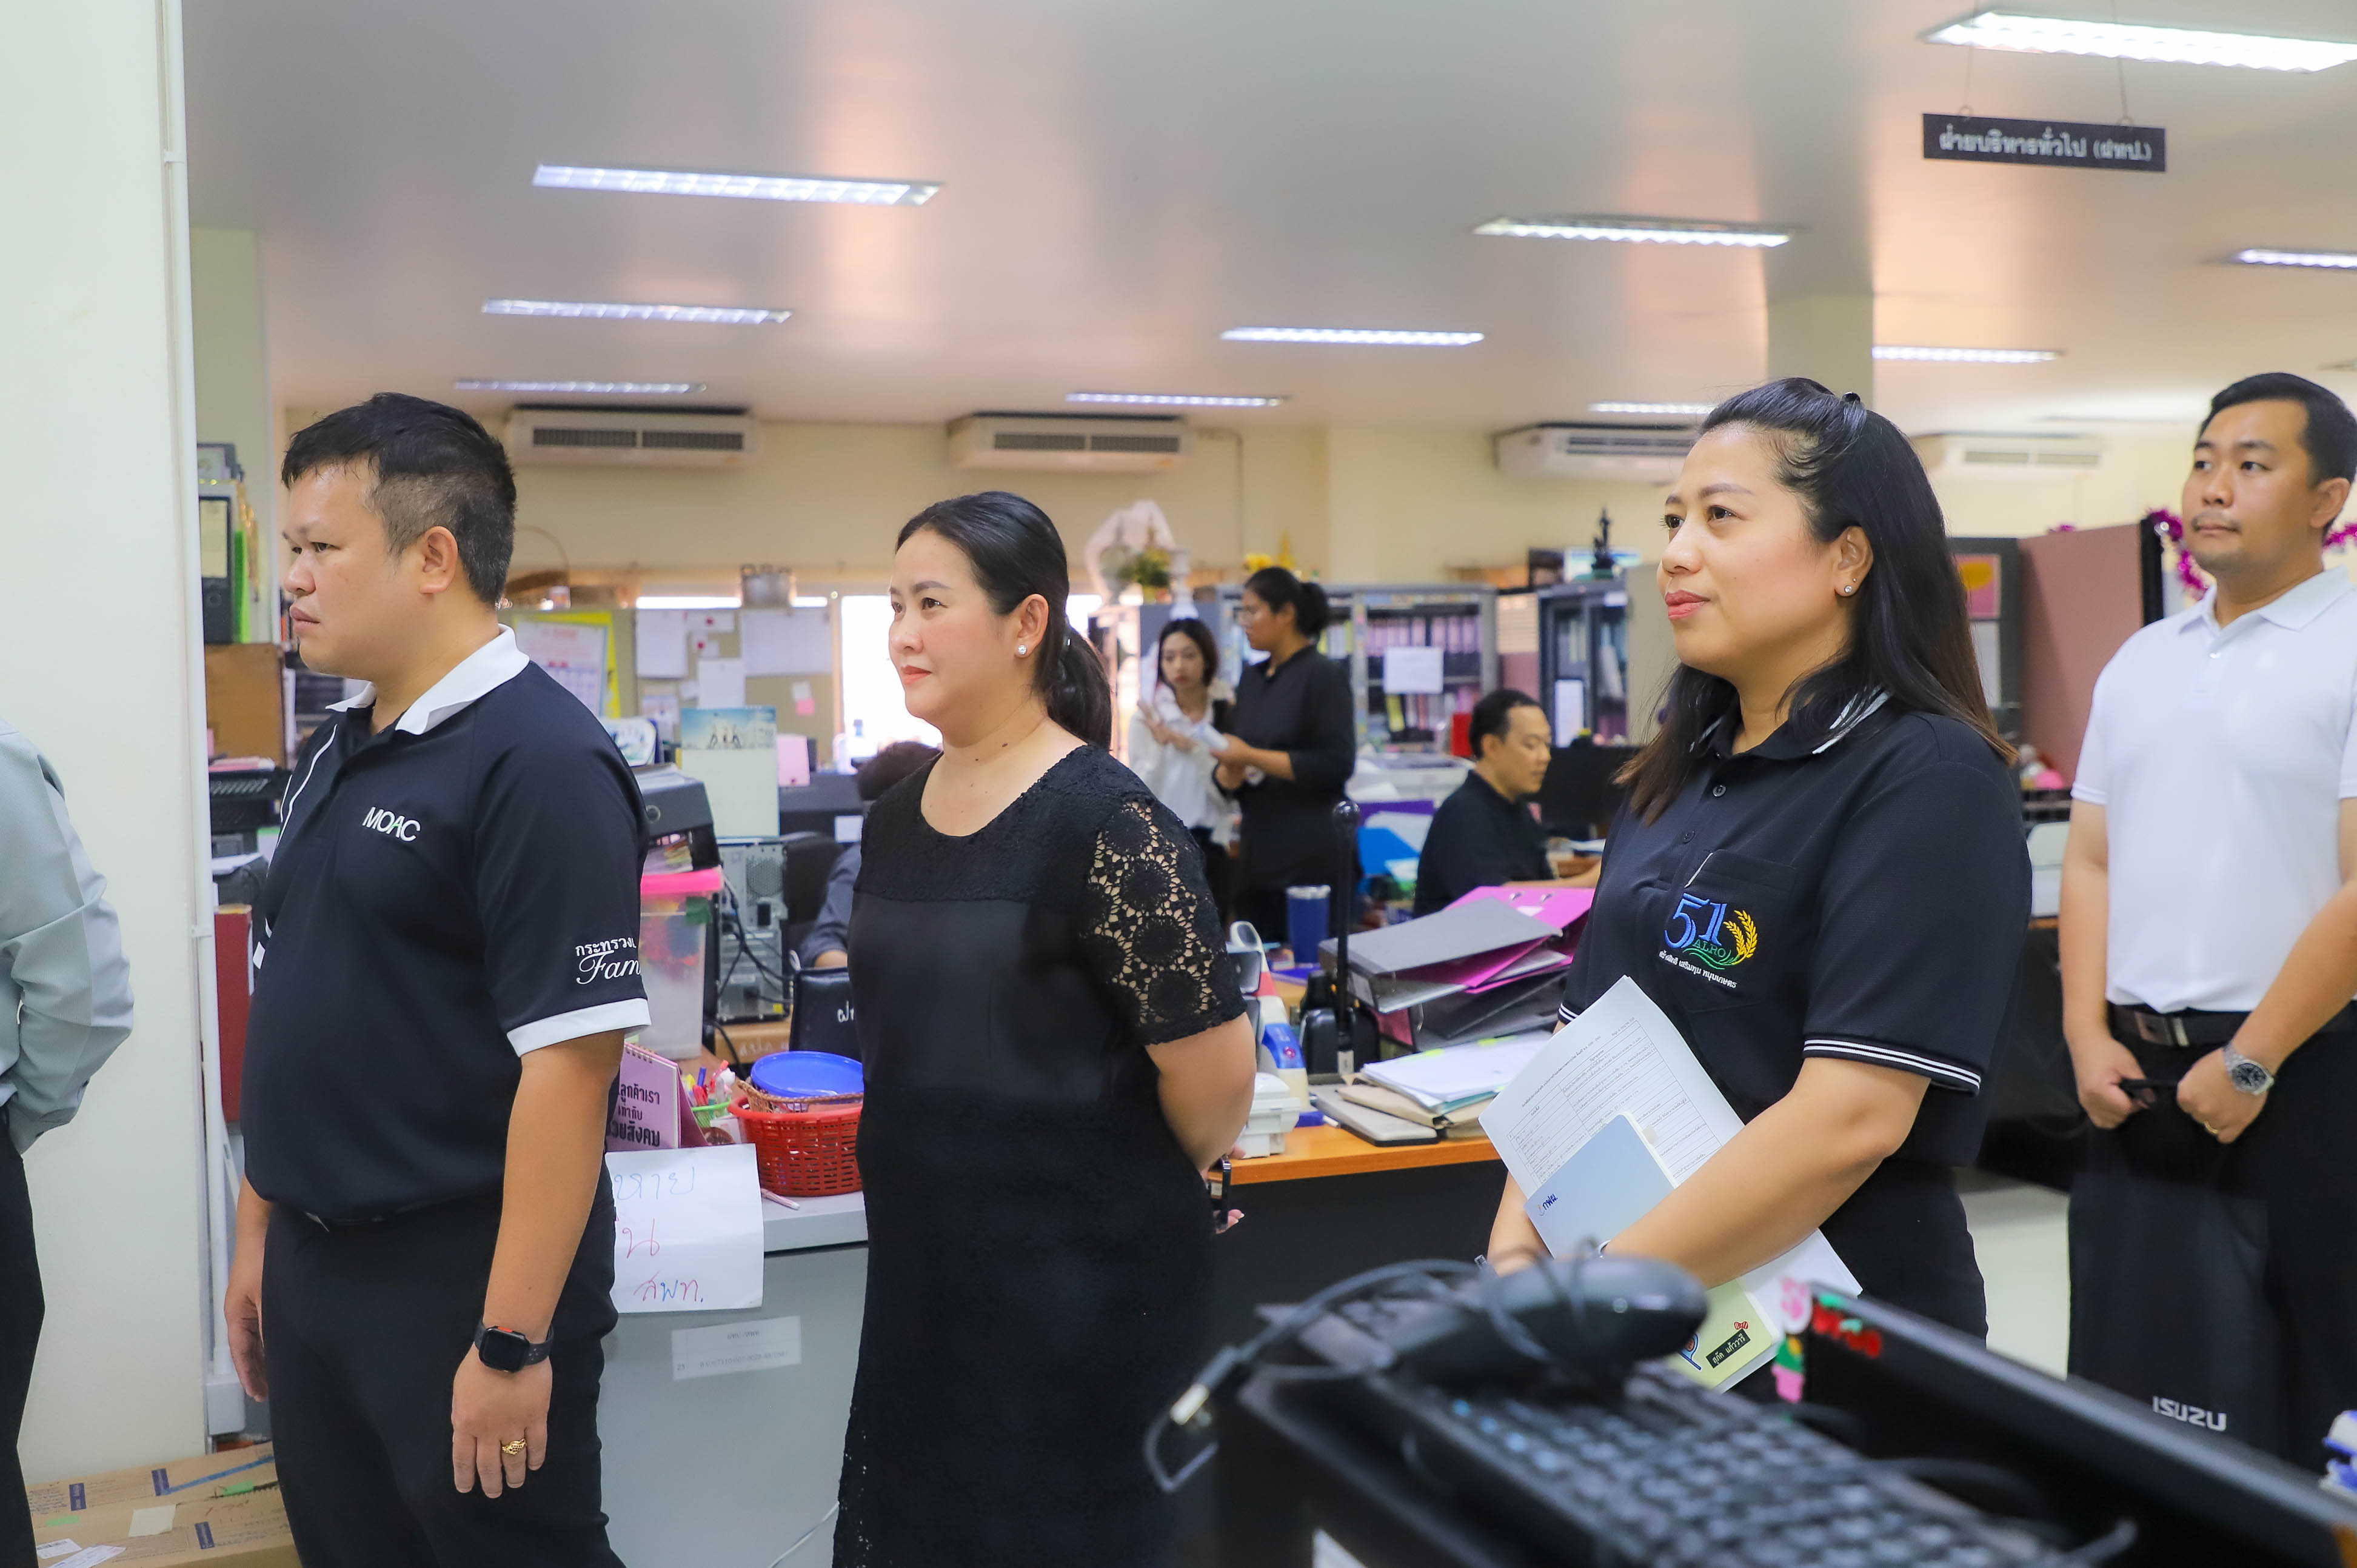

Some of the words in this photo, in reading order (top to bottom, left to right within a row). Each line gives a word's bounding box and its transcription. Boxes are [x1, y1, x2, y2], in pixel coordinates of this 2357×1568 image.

[1939, 122, 2087, 158] ฝ่ายบริหารทั่วไป
[362, 806, 421, 842] MOAC
[1664, 892, 1728, 949] 51
[1692, 939, 1727, 958] ALRO
[2153, 1395, 2227, 1432] ISUZU
